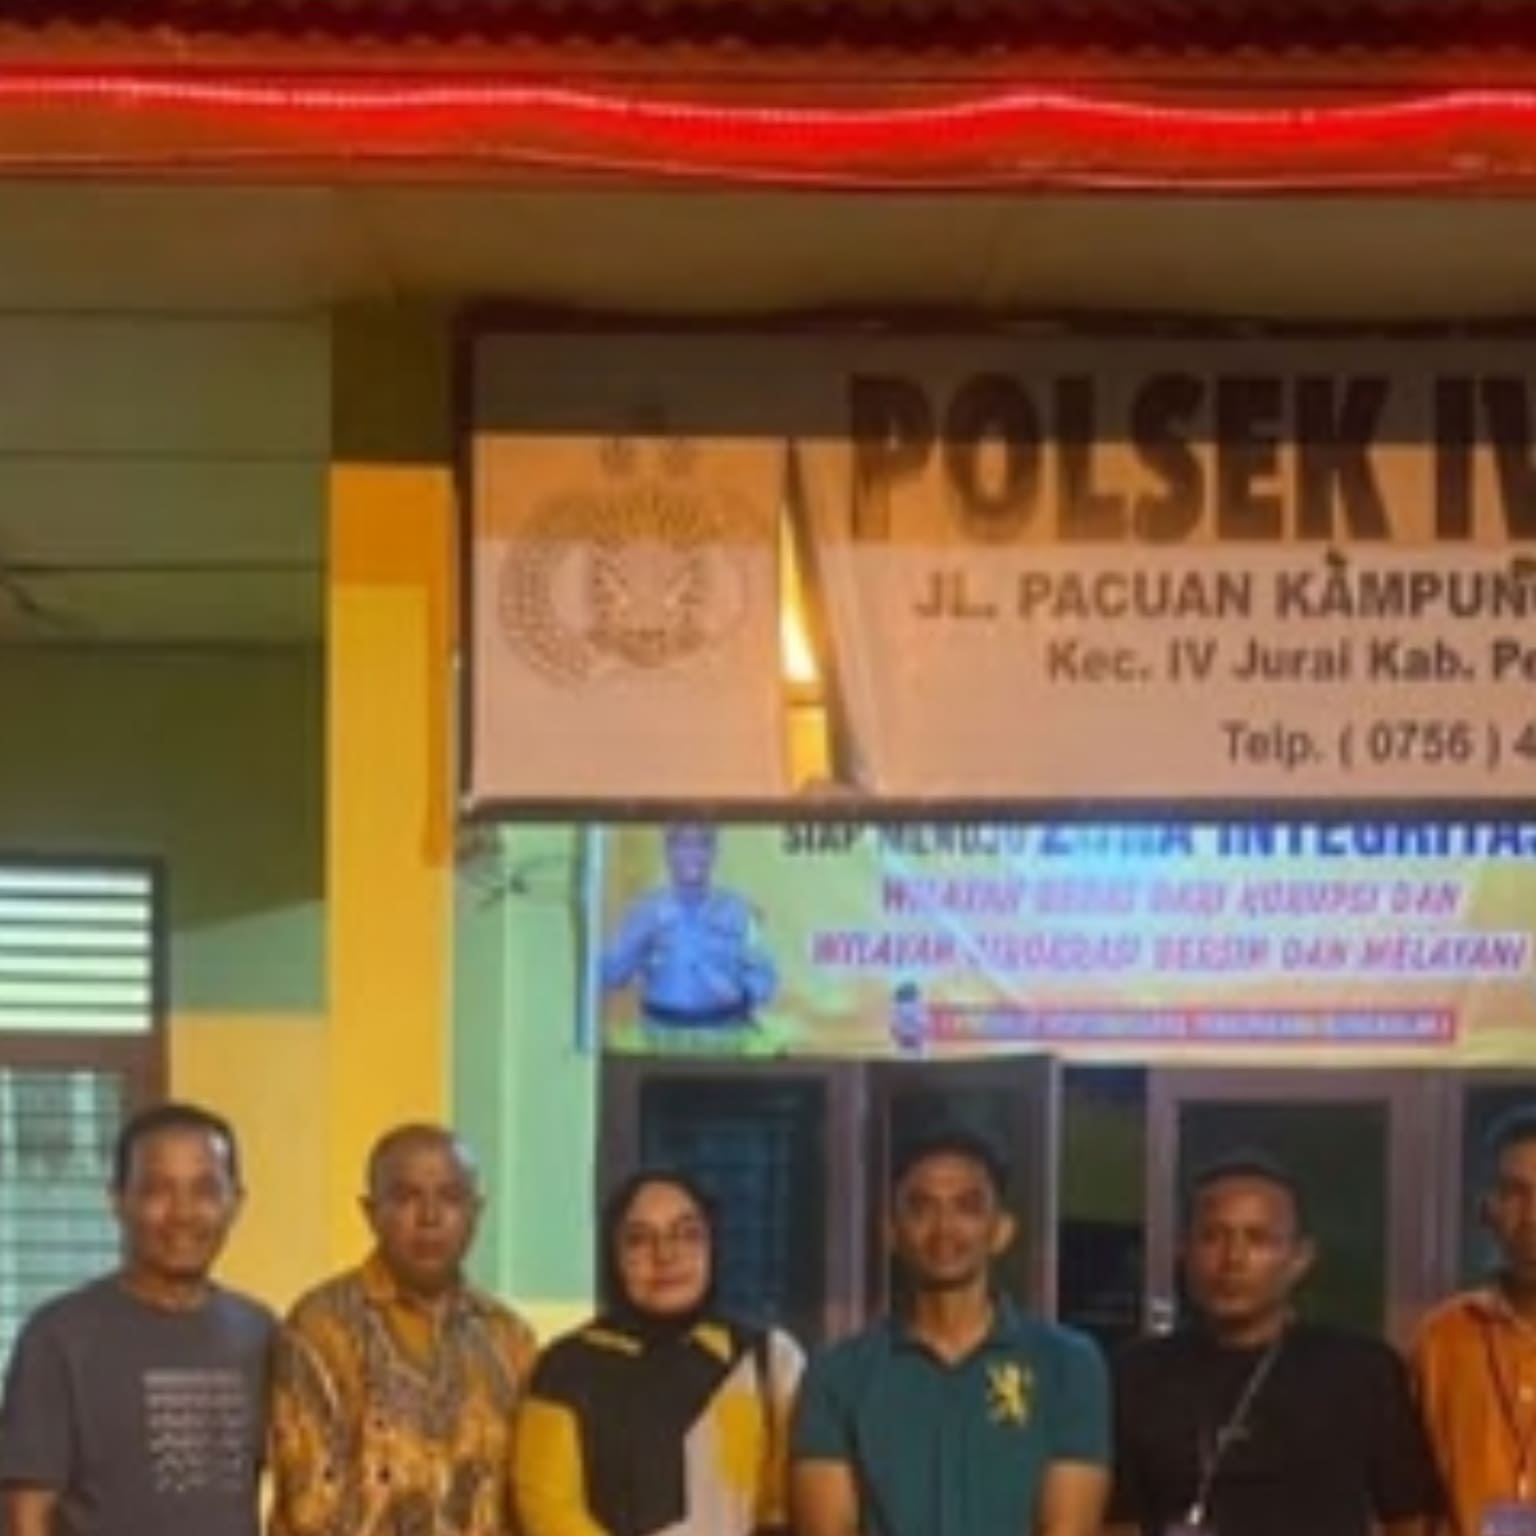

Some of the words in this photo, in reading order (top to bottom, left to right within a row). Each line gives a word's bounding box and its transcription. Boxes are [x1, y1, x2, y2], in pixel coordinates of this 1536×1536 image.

[850, 374, 1394, 542] POLSEK
[913, 572, 998, 619] JL.
[1018, 571, 1253, 619] PACUAN
[1047, 641, 1151, 682] Kec.
[1168, 641, 1218, 681] IV
[1232, 640, 1352, 682] Jurai
[1368, 640, 1476, 682] Kab.
[1369, 723, 1474, 763] 0756
